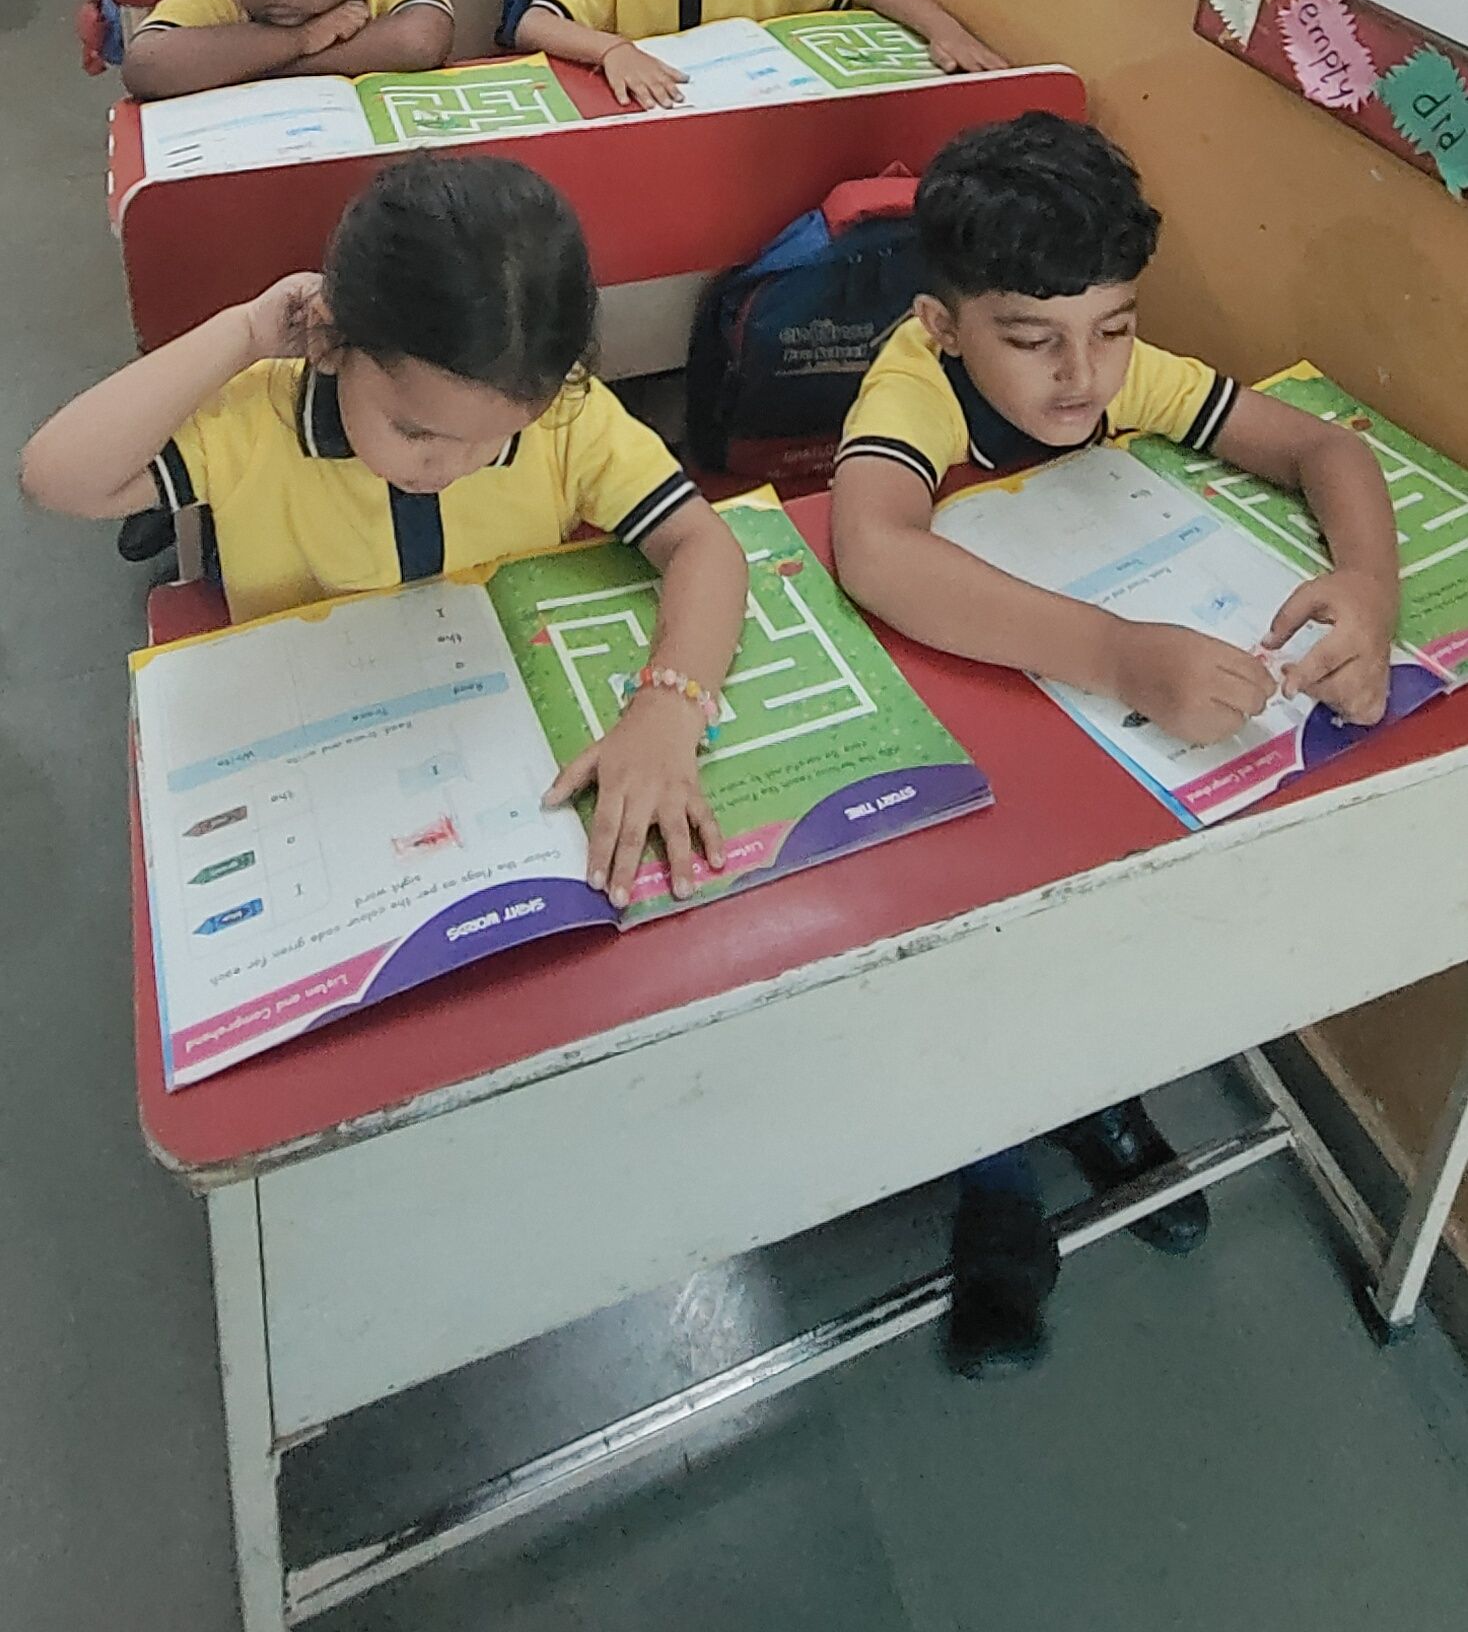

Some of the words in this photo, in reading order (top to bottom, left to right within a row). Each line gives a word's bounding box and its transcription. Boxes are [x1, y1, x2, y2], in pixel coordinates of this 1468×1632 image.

[1299, 3, 1354, 100] empty
[1412, 93, 1466, 153] did
[843, 801, 877, 821] TIME
[877, 785, 917, 811] STORY
[503, 895, 547, 921] SIGHT
[446, 910, 500, 942] WORDS
[304, 973, 349, 998] Listen
[276, 994, 301, 1013] and
